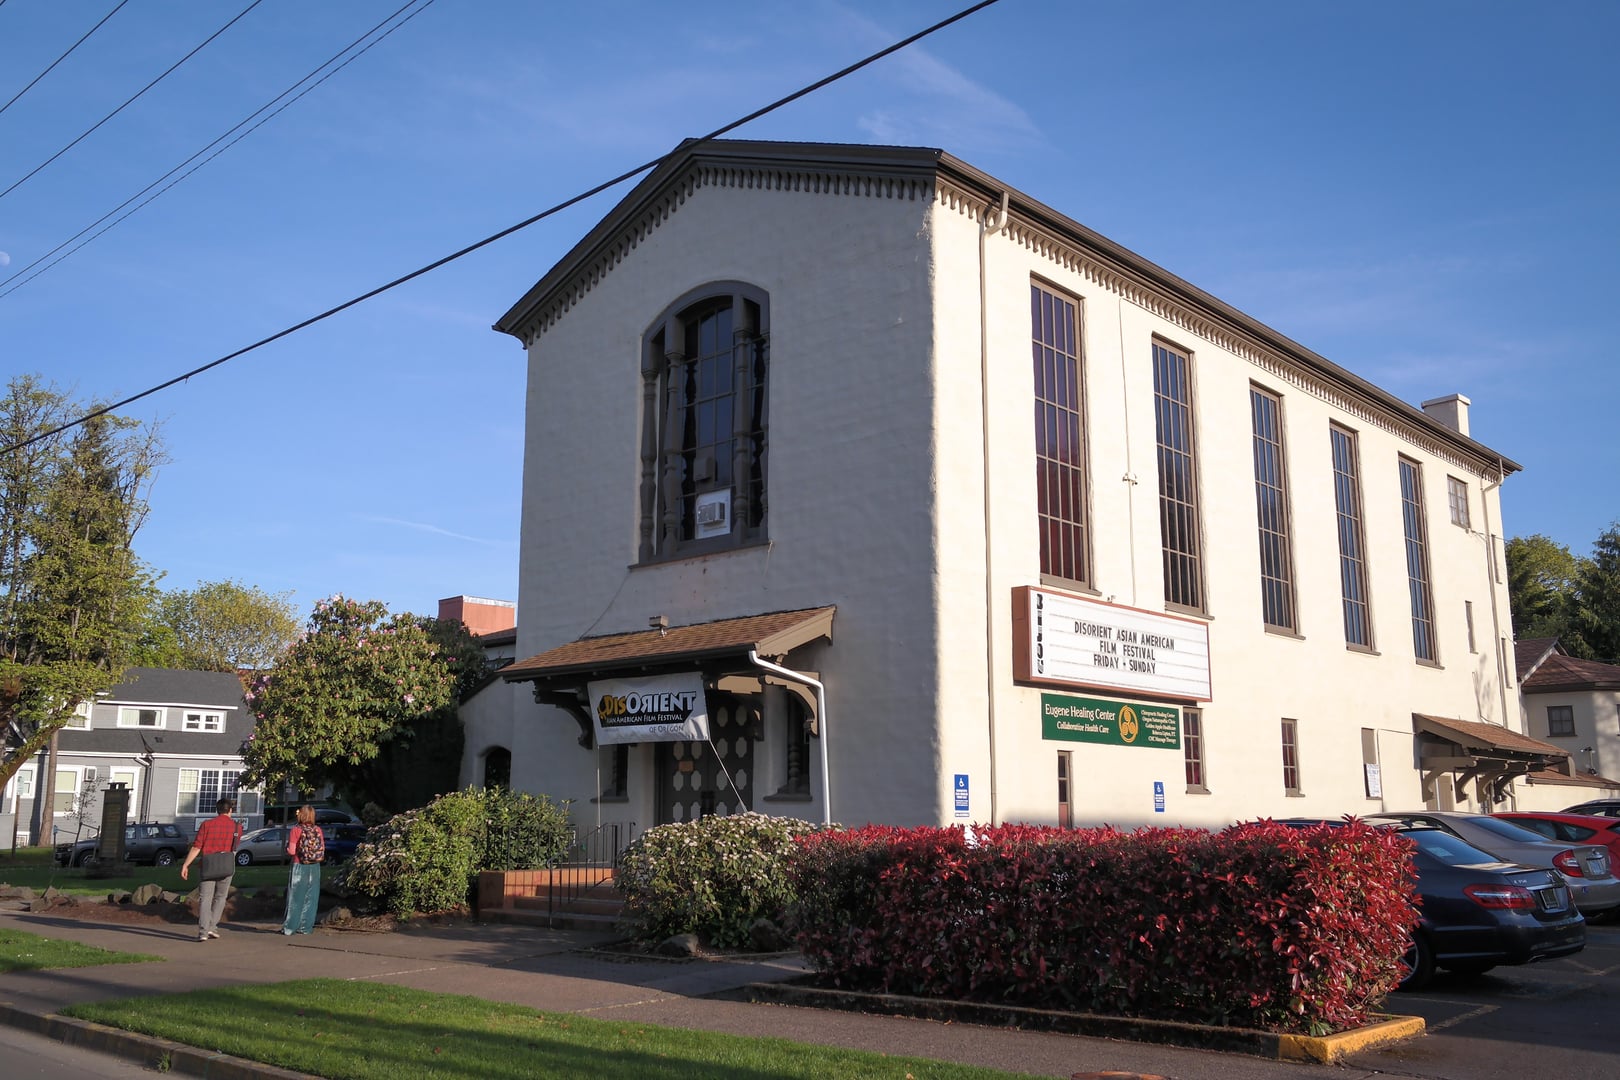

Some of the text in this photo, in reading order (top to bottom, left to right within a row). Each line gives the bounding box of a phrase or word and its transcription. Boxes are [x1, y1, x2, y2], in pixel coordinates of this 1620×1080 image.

[1074, 621, 1175, 650] DISORIENT ASIAN AMERICAN
[1100, 640, 1156, 660] FILM FESTIVAL
[1093, 654, 1119, 669] FRIDAY
[1129, 659, 1156, 674] SUNDAY
[1045, 703, 1116, 721] Eugene Healing Center
[1084, 723, 1099, 733] Health
[1099, 724, 1110, 733] Care
